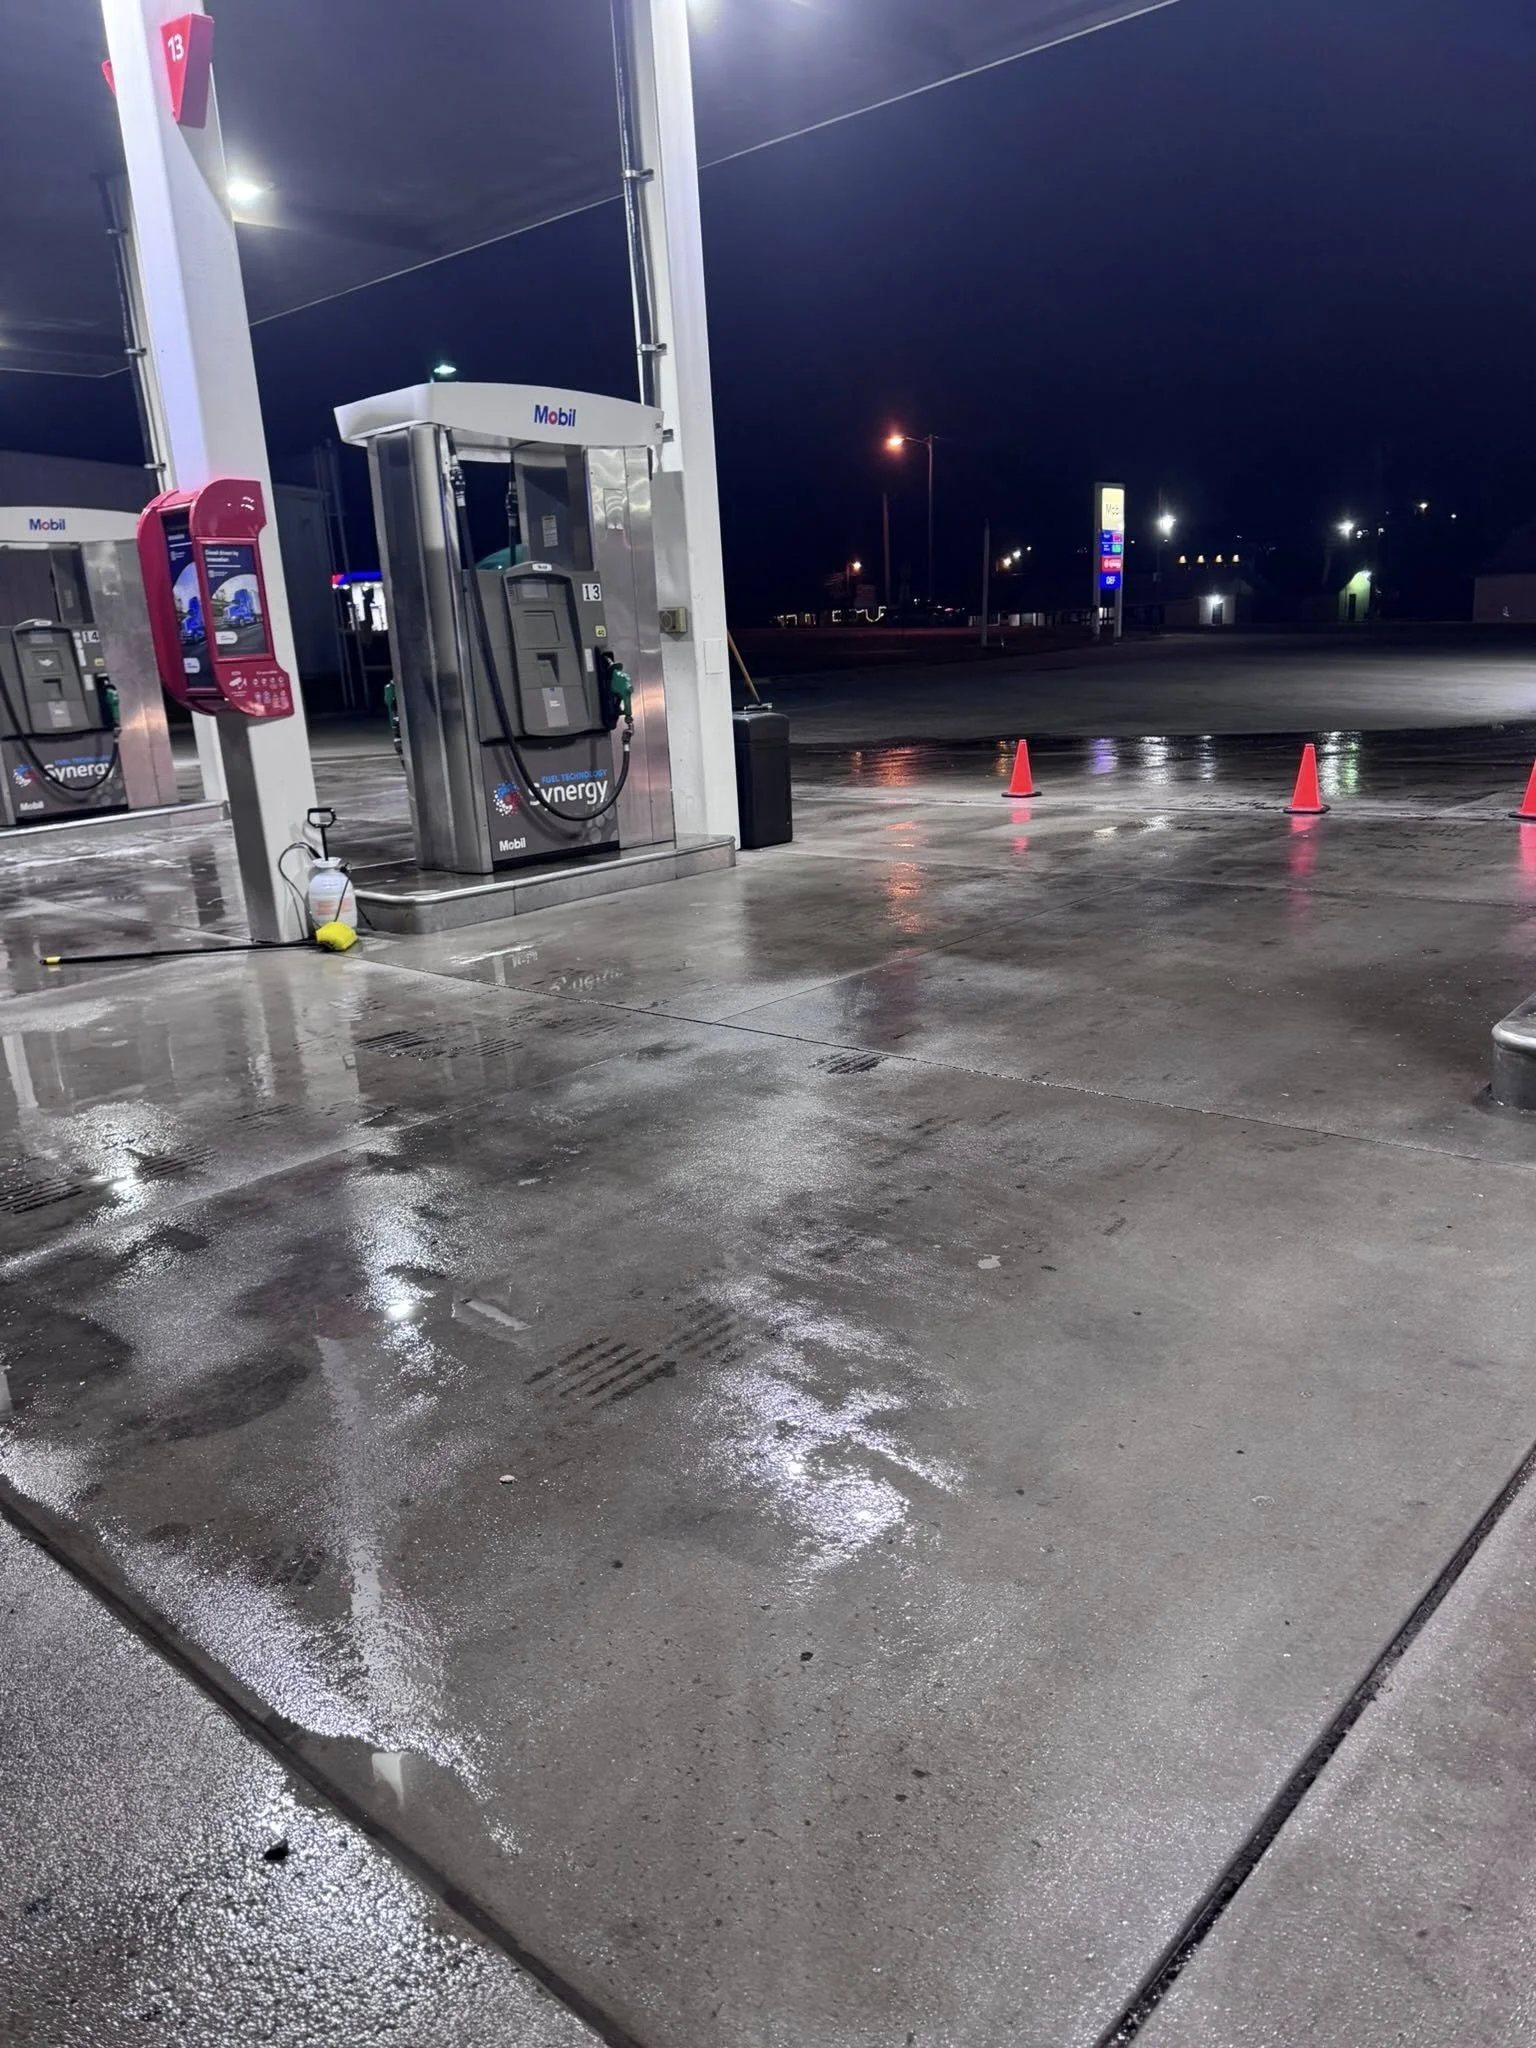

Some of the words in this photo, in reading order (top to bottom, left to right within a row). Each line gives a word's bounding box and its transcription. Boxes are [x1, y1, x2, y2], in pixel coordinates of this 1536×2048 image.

[167, 33, 185, 62] 13
[535, 404, 576, 427] Mobil
[29, 518, 66, 531] Mobil
[584, 585, 600, 600] 13
[84, 632, 99, 642] 14
[541, 775, 560, 784] FUEL
[499, 837, 526, 851] Mobil
